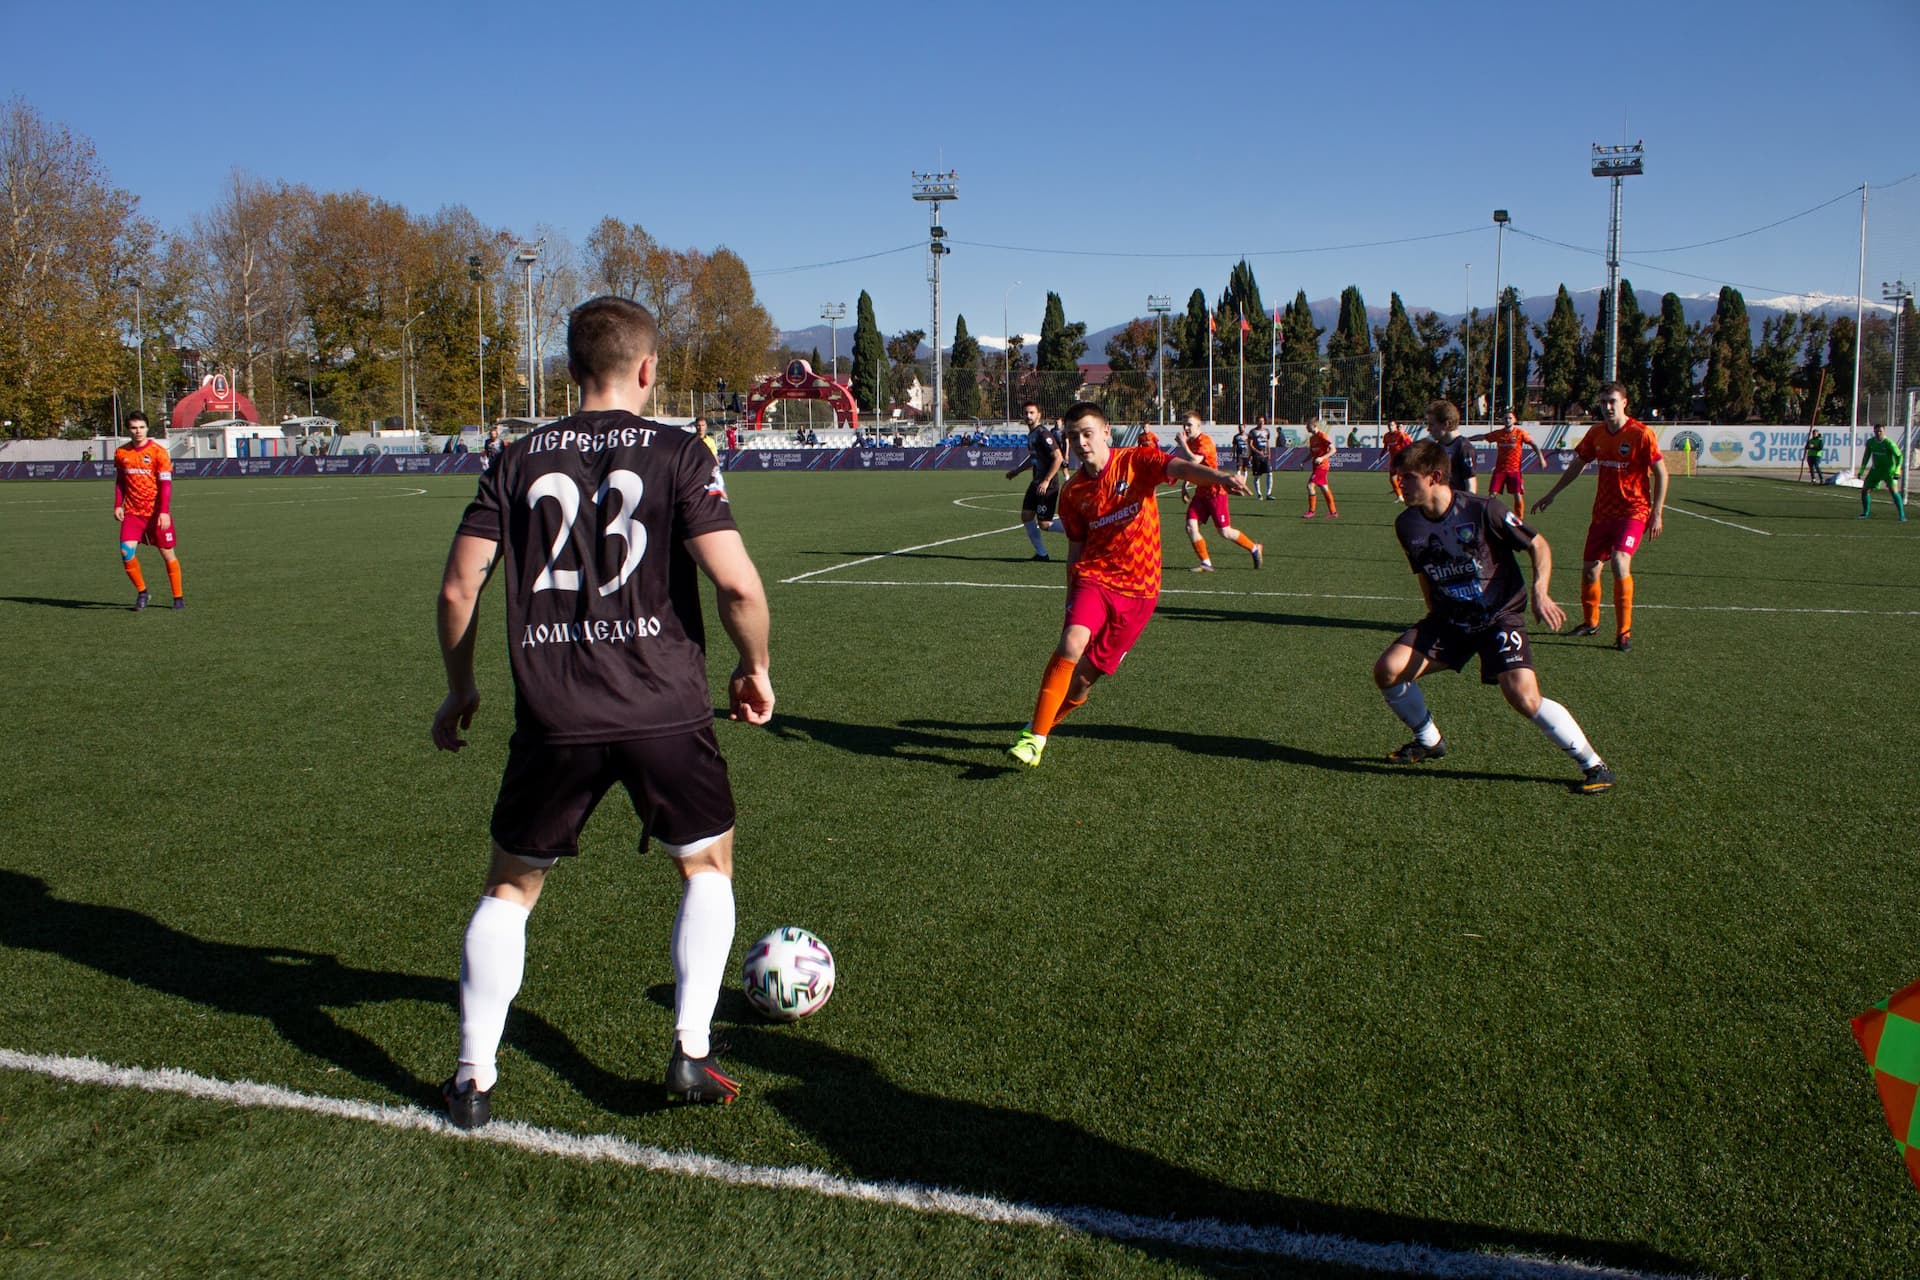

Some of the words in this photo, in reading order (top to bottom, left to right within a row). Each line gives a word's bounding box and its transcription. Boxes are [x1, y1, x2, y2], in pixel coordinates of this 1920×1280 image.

[528, 428, 656, 454] ПЕРЕСВЕТ
[1335, 435, 1384, 449] РСТ
[1749, 430, 1767, 461] 3
[1770, 431, 1874, 447] УНИКЛЬНЫ
[527, 469, 648, 597] 23
[1496, 630, 1523, 653] 29
